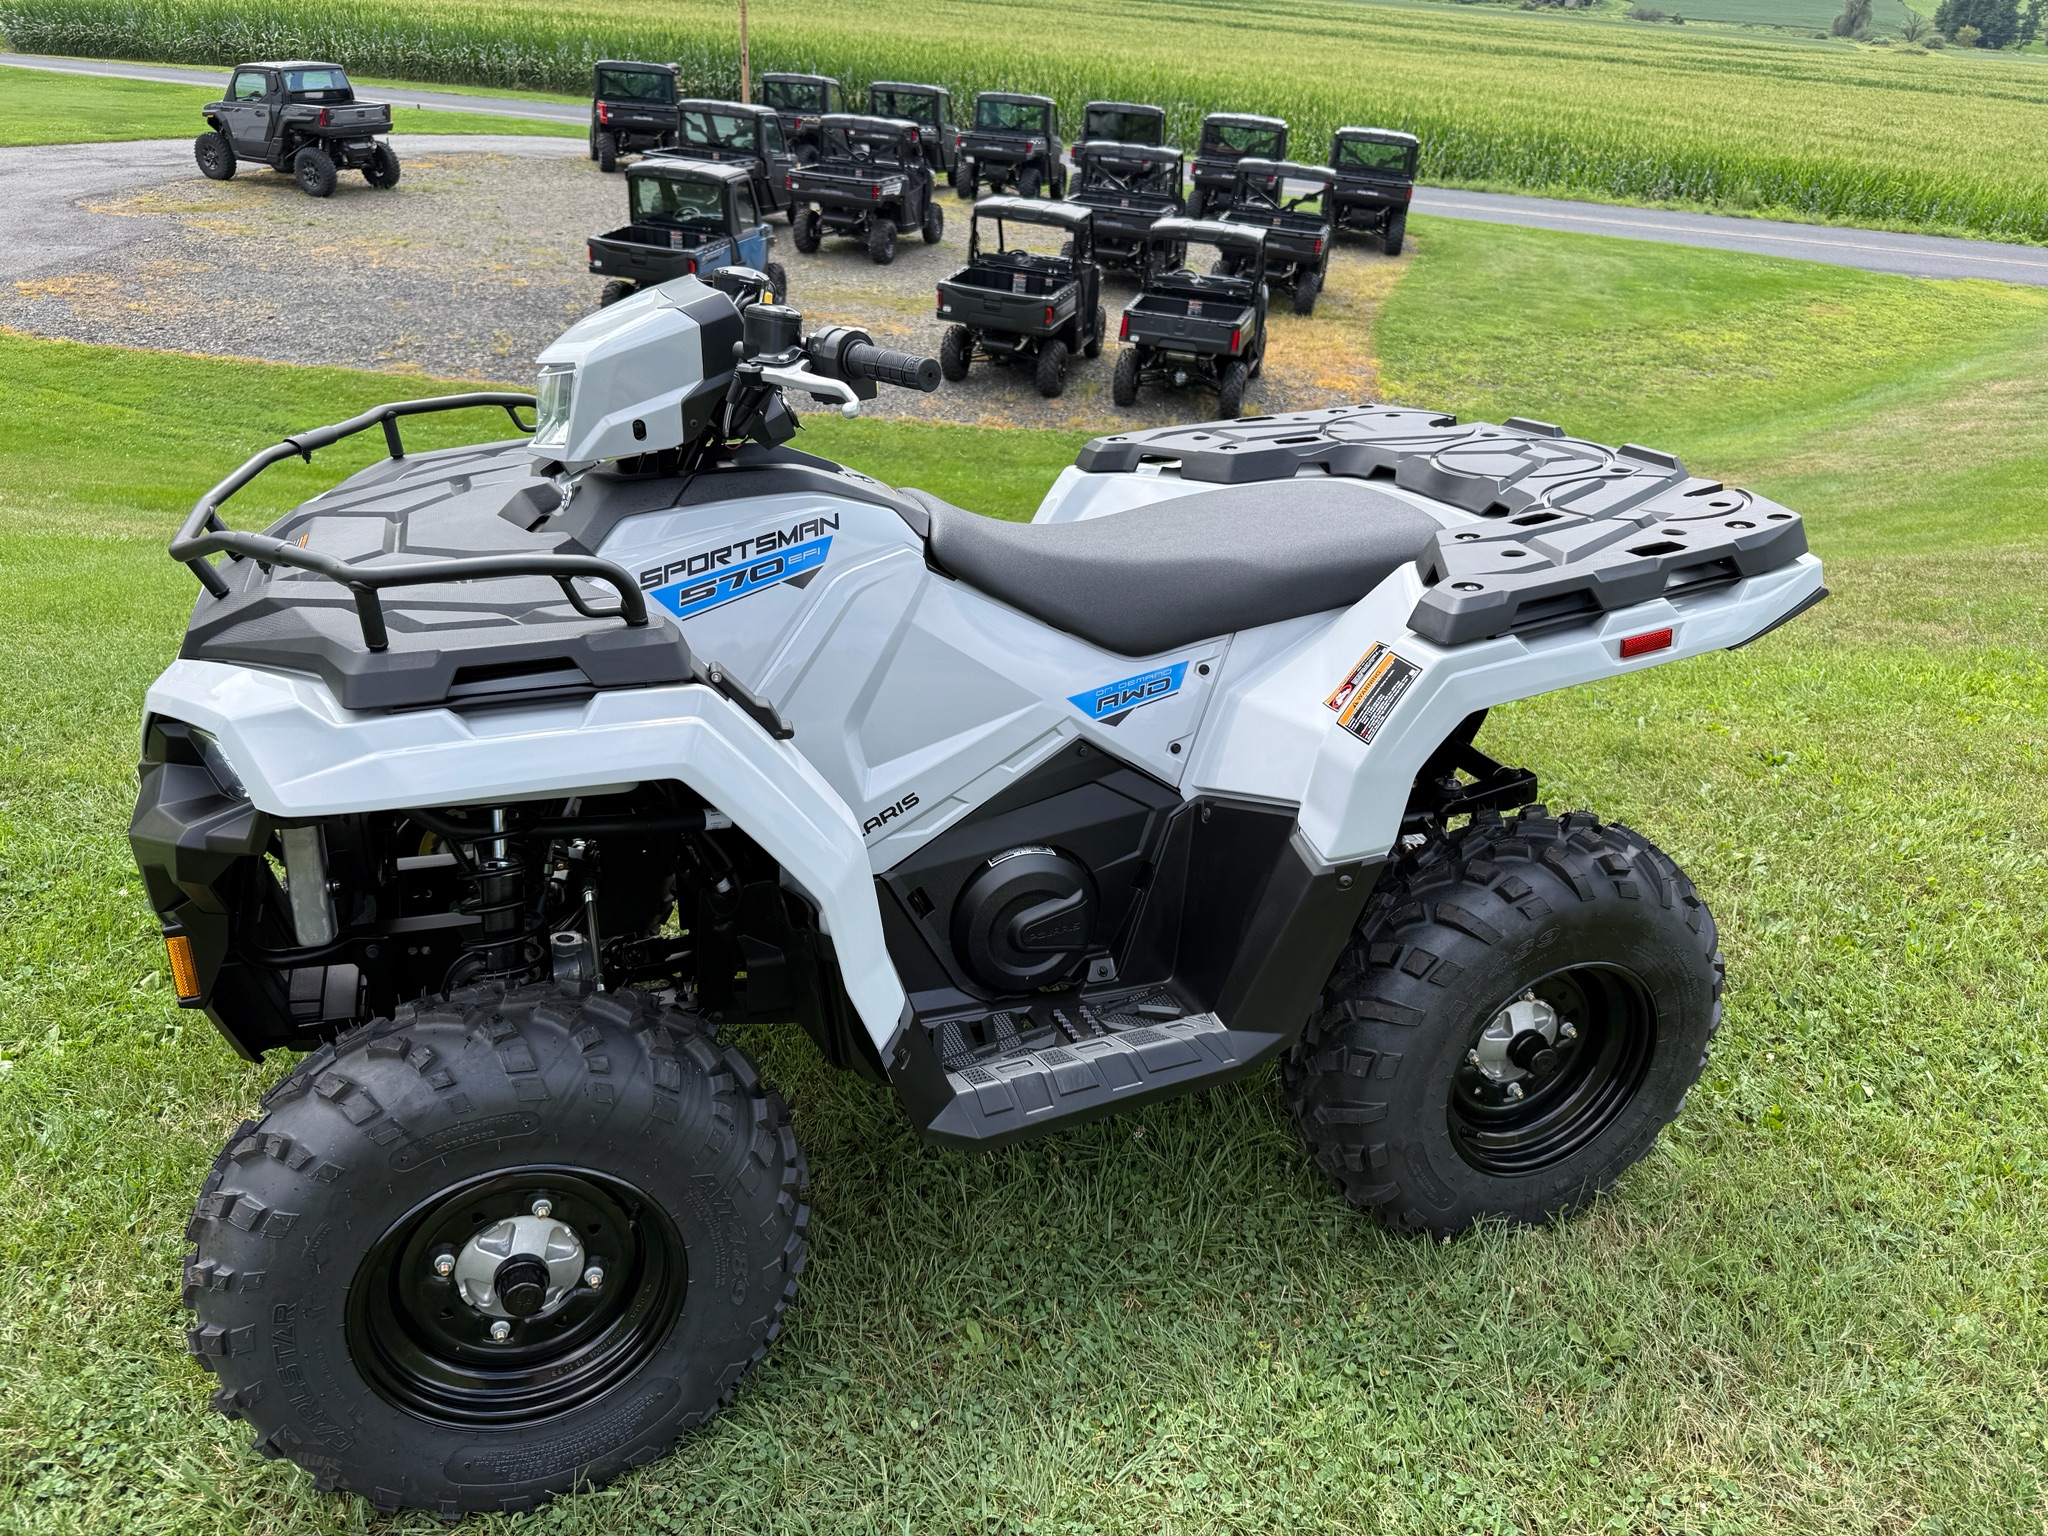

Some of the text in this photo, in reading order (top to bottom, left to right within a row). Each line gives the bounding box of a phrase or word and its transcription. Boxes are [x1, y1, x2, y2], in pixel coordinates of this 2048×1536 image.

[640, 512, 840, 590] SPORTSMAN
[679, 547, 821, 609] 570 EFI
[1095, 668, 1173, 697] ON DEMAND
[1096, 677, 1172, 714] AWD
[1357, 670, 1382, 700] WARNING
[862, 791, 920, 837] ARIS
[271, 1303, 355, 1452] CARLSTAR
